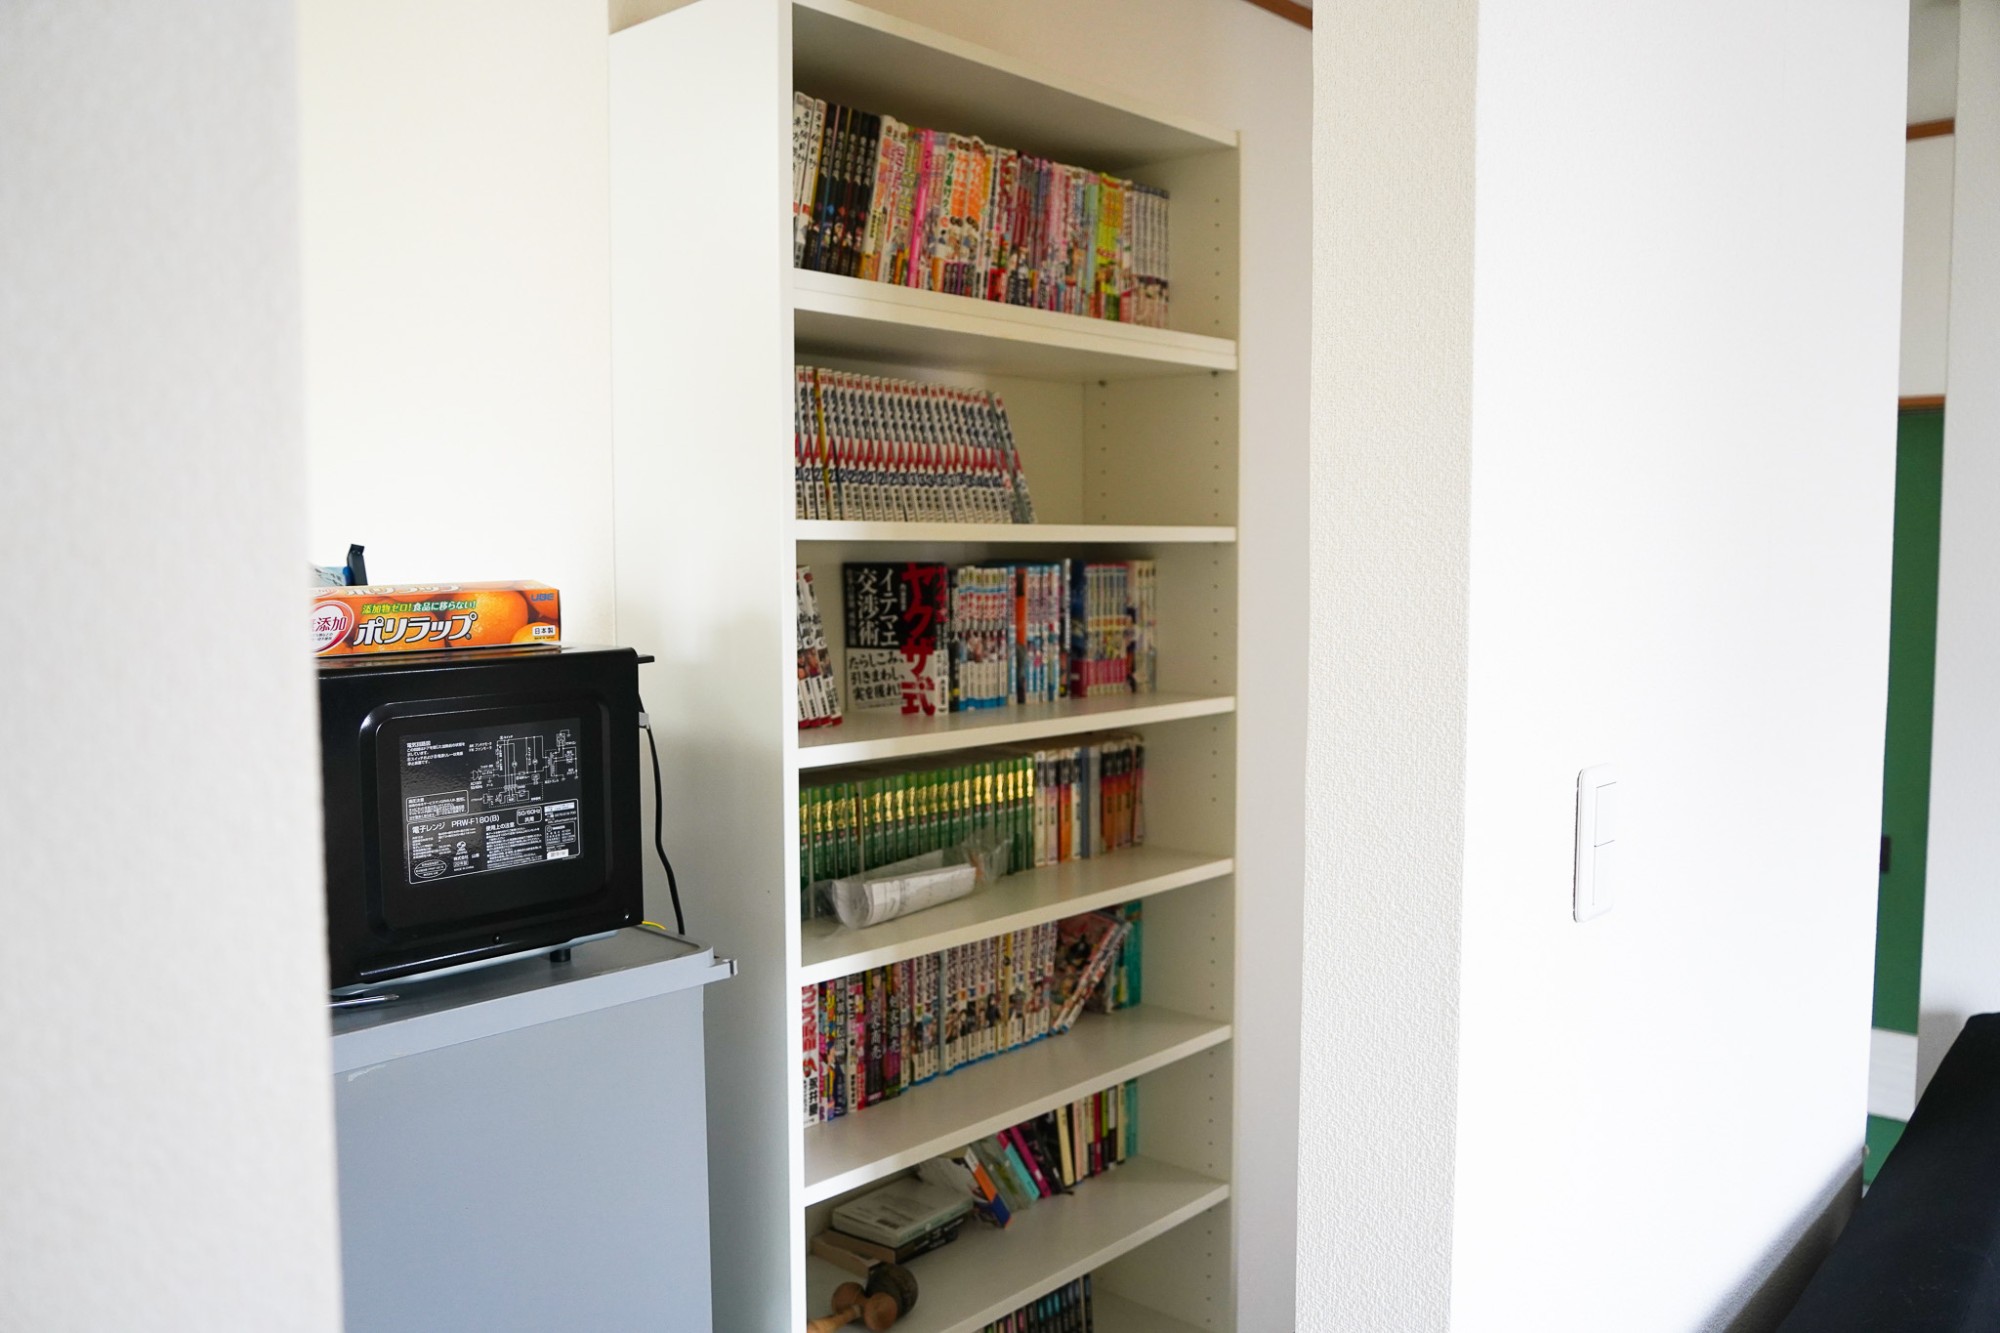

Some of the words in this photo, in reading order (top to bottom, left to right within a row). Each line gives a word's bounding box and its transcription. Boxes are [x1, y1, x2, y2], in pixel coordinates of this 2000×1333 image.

[879, 567, 900, 647] イテマエ
[353, 611, 478, 647] ポリラップ
[534, 626, 554, 635] 日本製
[412, 821, 446, 834] 電子レンジ
